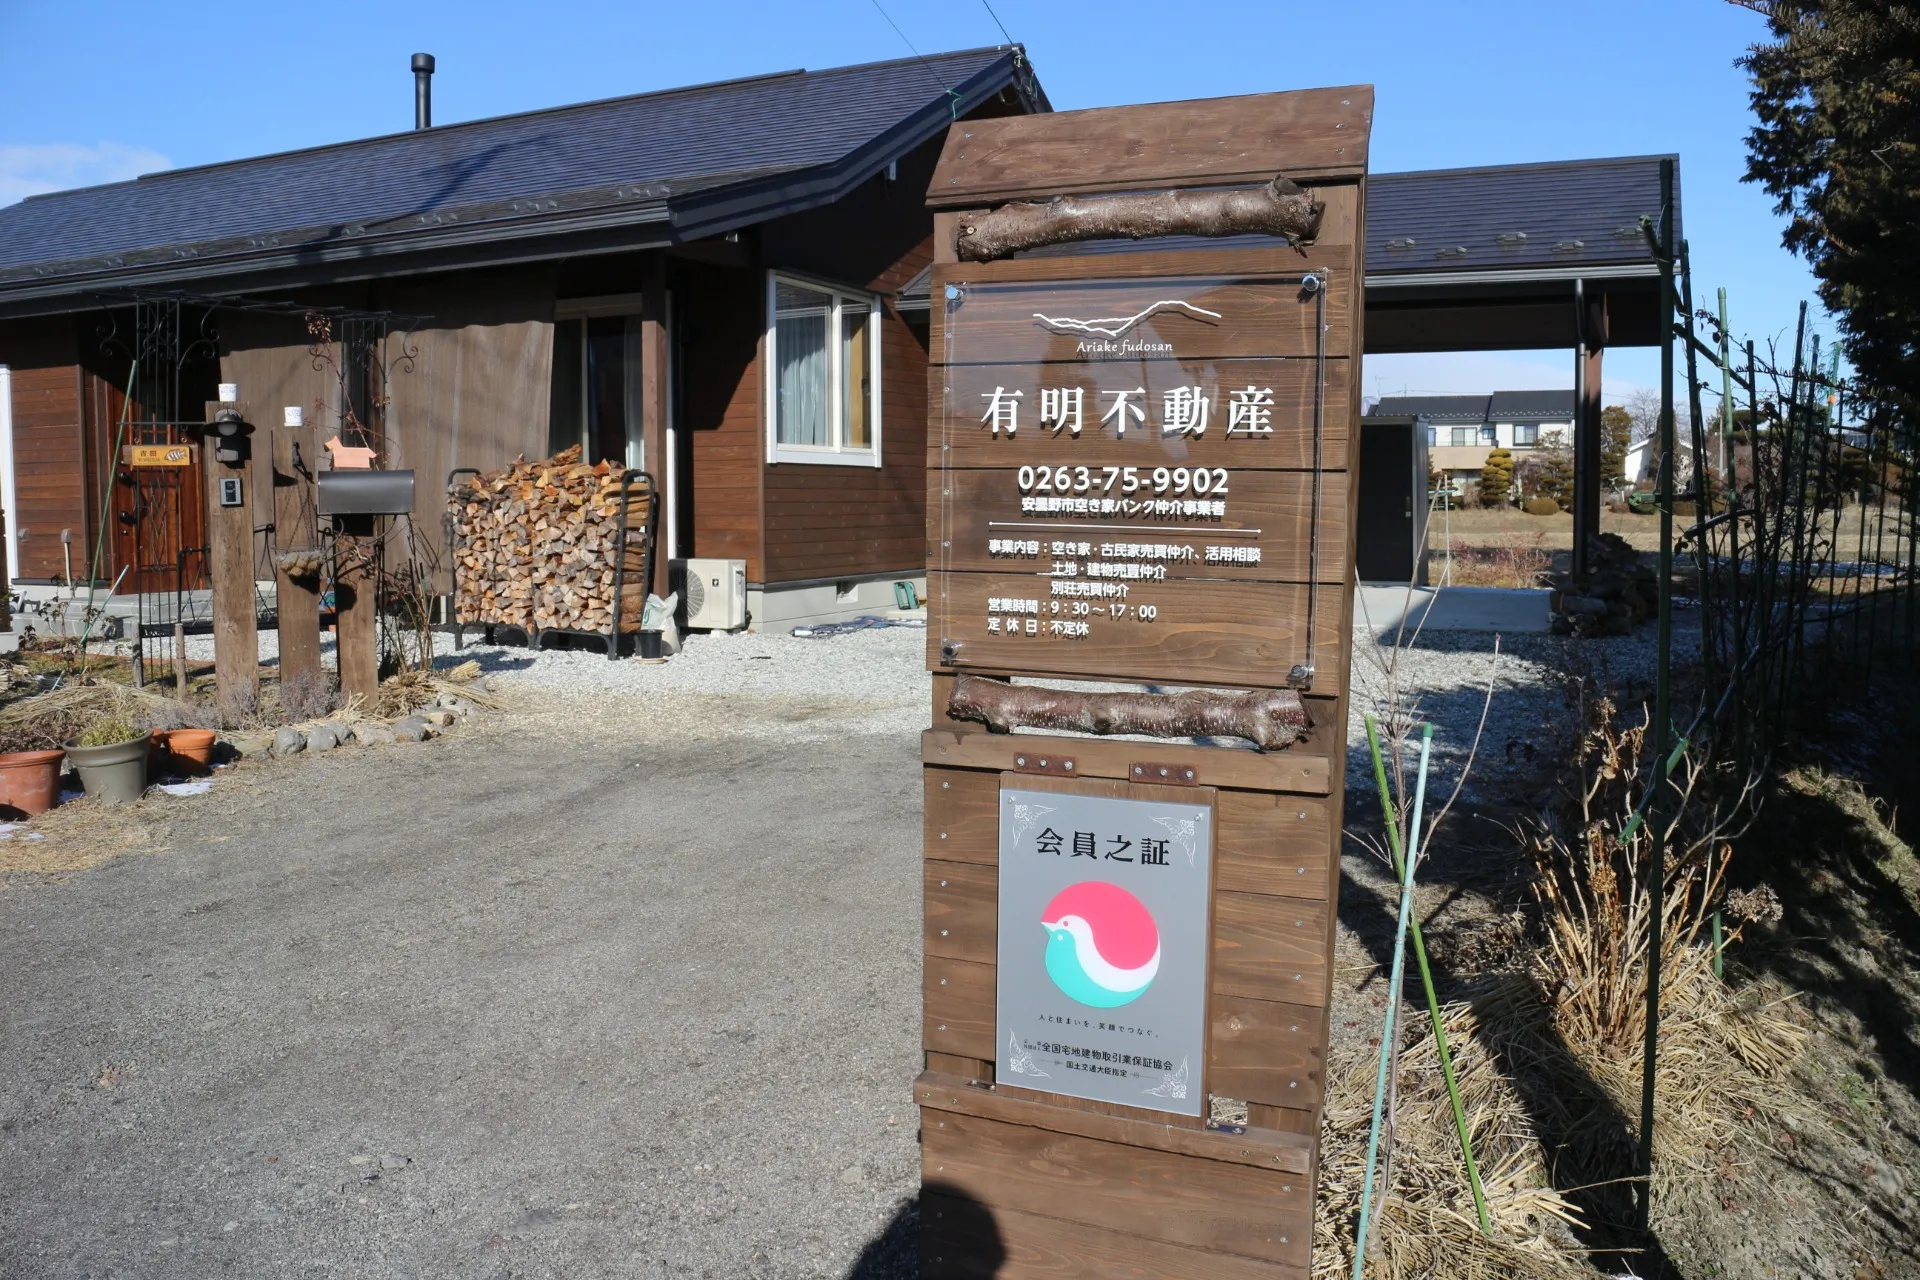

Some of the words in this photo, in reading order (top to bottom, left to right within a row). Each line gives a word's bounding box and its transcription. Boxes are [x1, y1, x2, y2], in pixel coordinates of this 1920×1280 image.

[1076, 340, 1118, 352] Ariake
[1119, 339, 1173, 355] fudosan
[980, 386, 1275, 434] 有明不動産
[1018, 465, 1229, 493] 0263-75-9902
[1021, 497, 1226, 516] 安曇野市空き家バンク仲介事業者
[1051, 580, 1129, 597] 別荘売買仲介
[1036, 827, 1170, 866] 会員之証
[1066, 1061, 1128, 1078] 国土交通大臣指定
